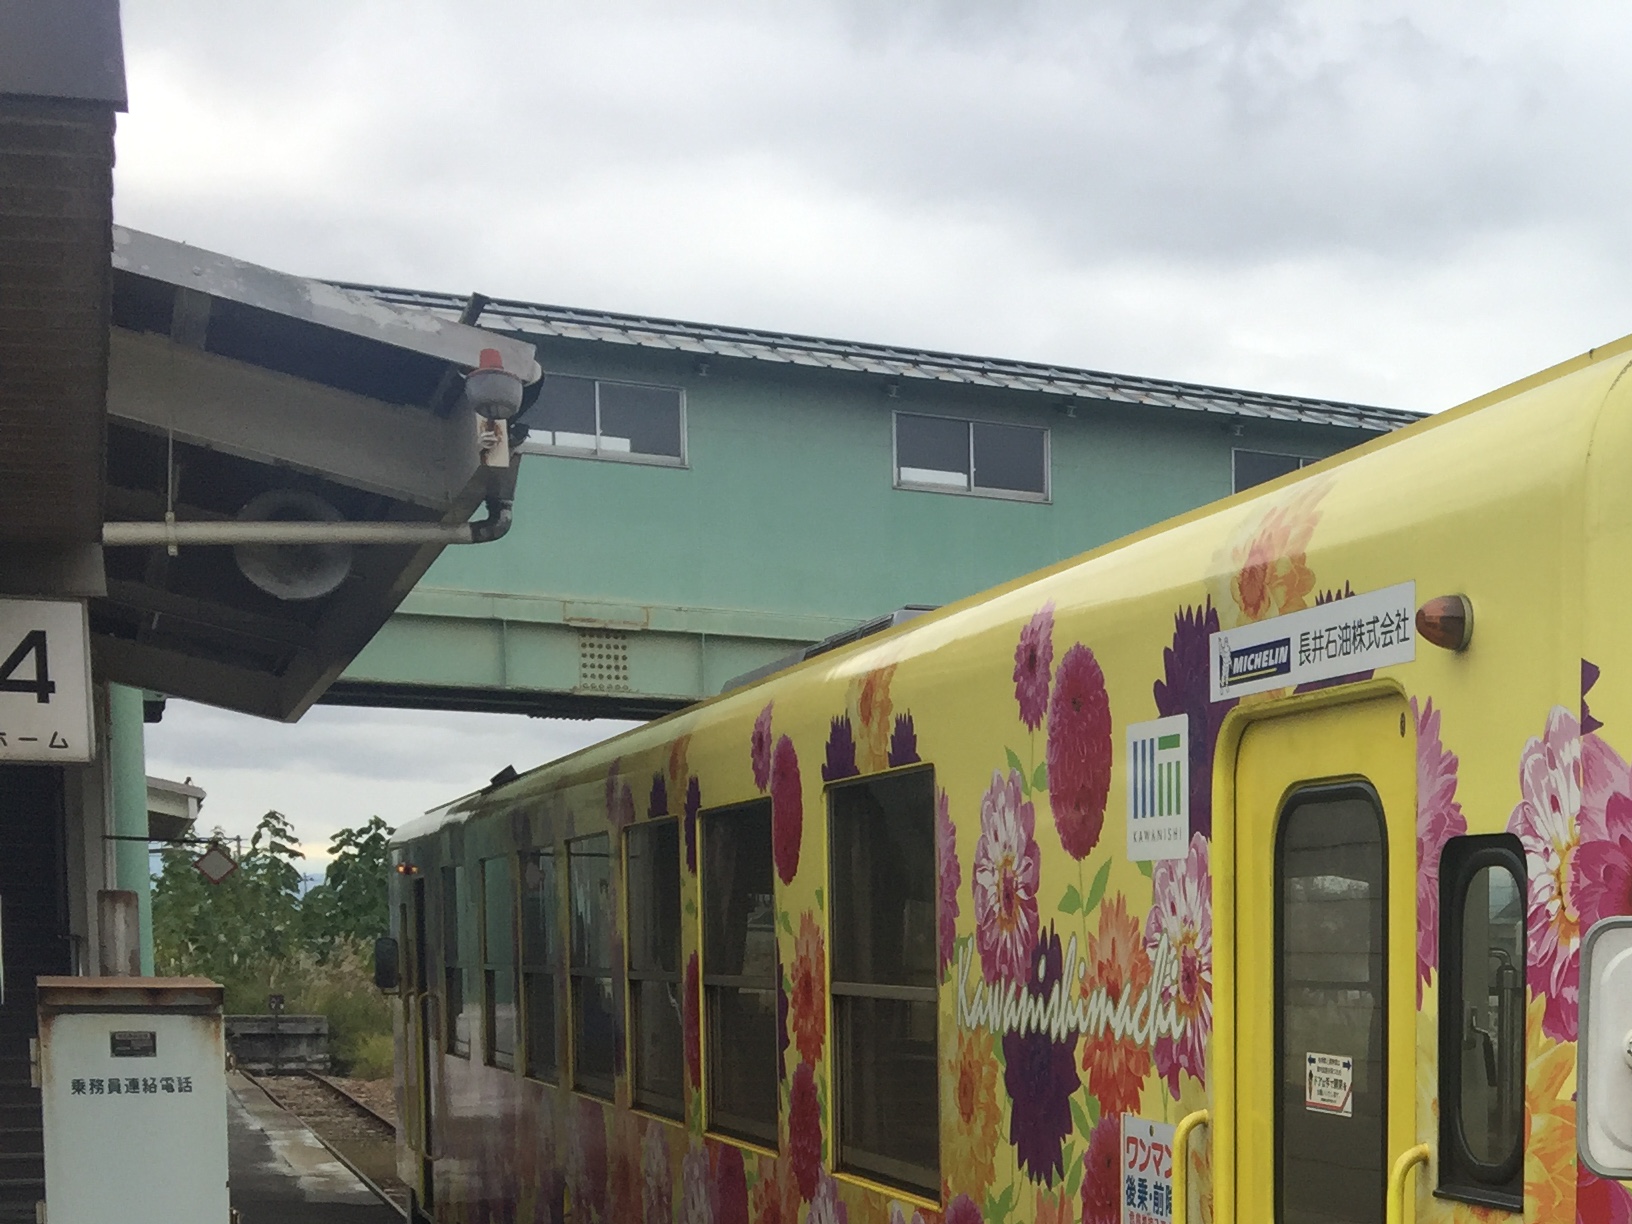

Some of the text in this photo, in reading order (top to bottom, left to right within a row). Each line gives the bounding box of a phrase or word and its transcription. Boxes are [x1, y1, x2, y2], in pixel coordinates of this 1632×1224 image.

[1298, 607, 1411, 667] 長井石油株式会社
[0, 630, 56, 704] 4
[1232, 645, 1290, 675] MICHELIN
[1132, 827, 1183, 843] KAWANISHI
[71, 1076, 192, 1095] 乗務員連絡電話
